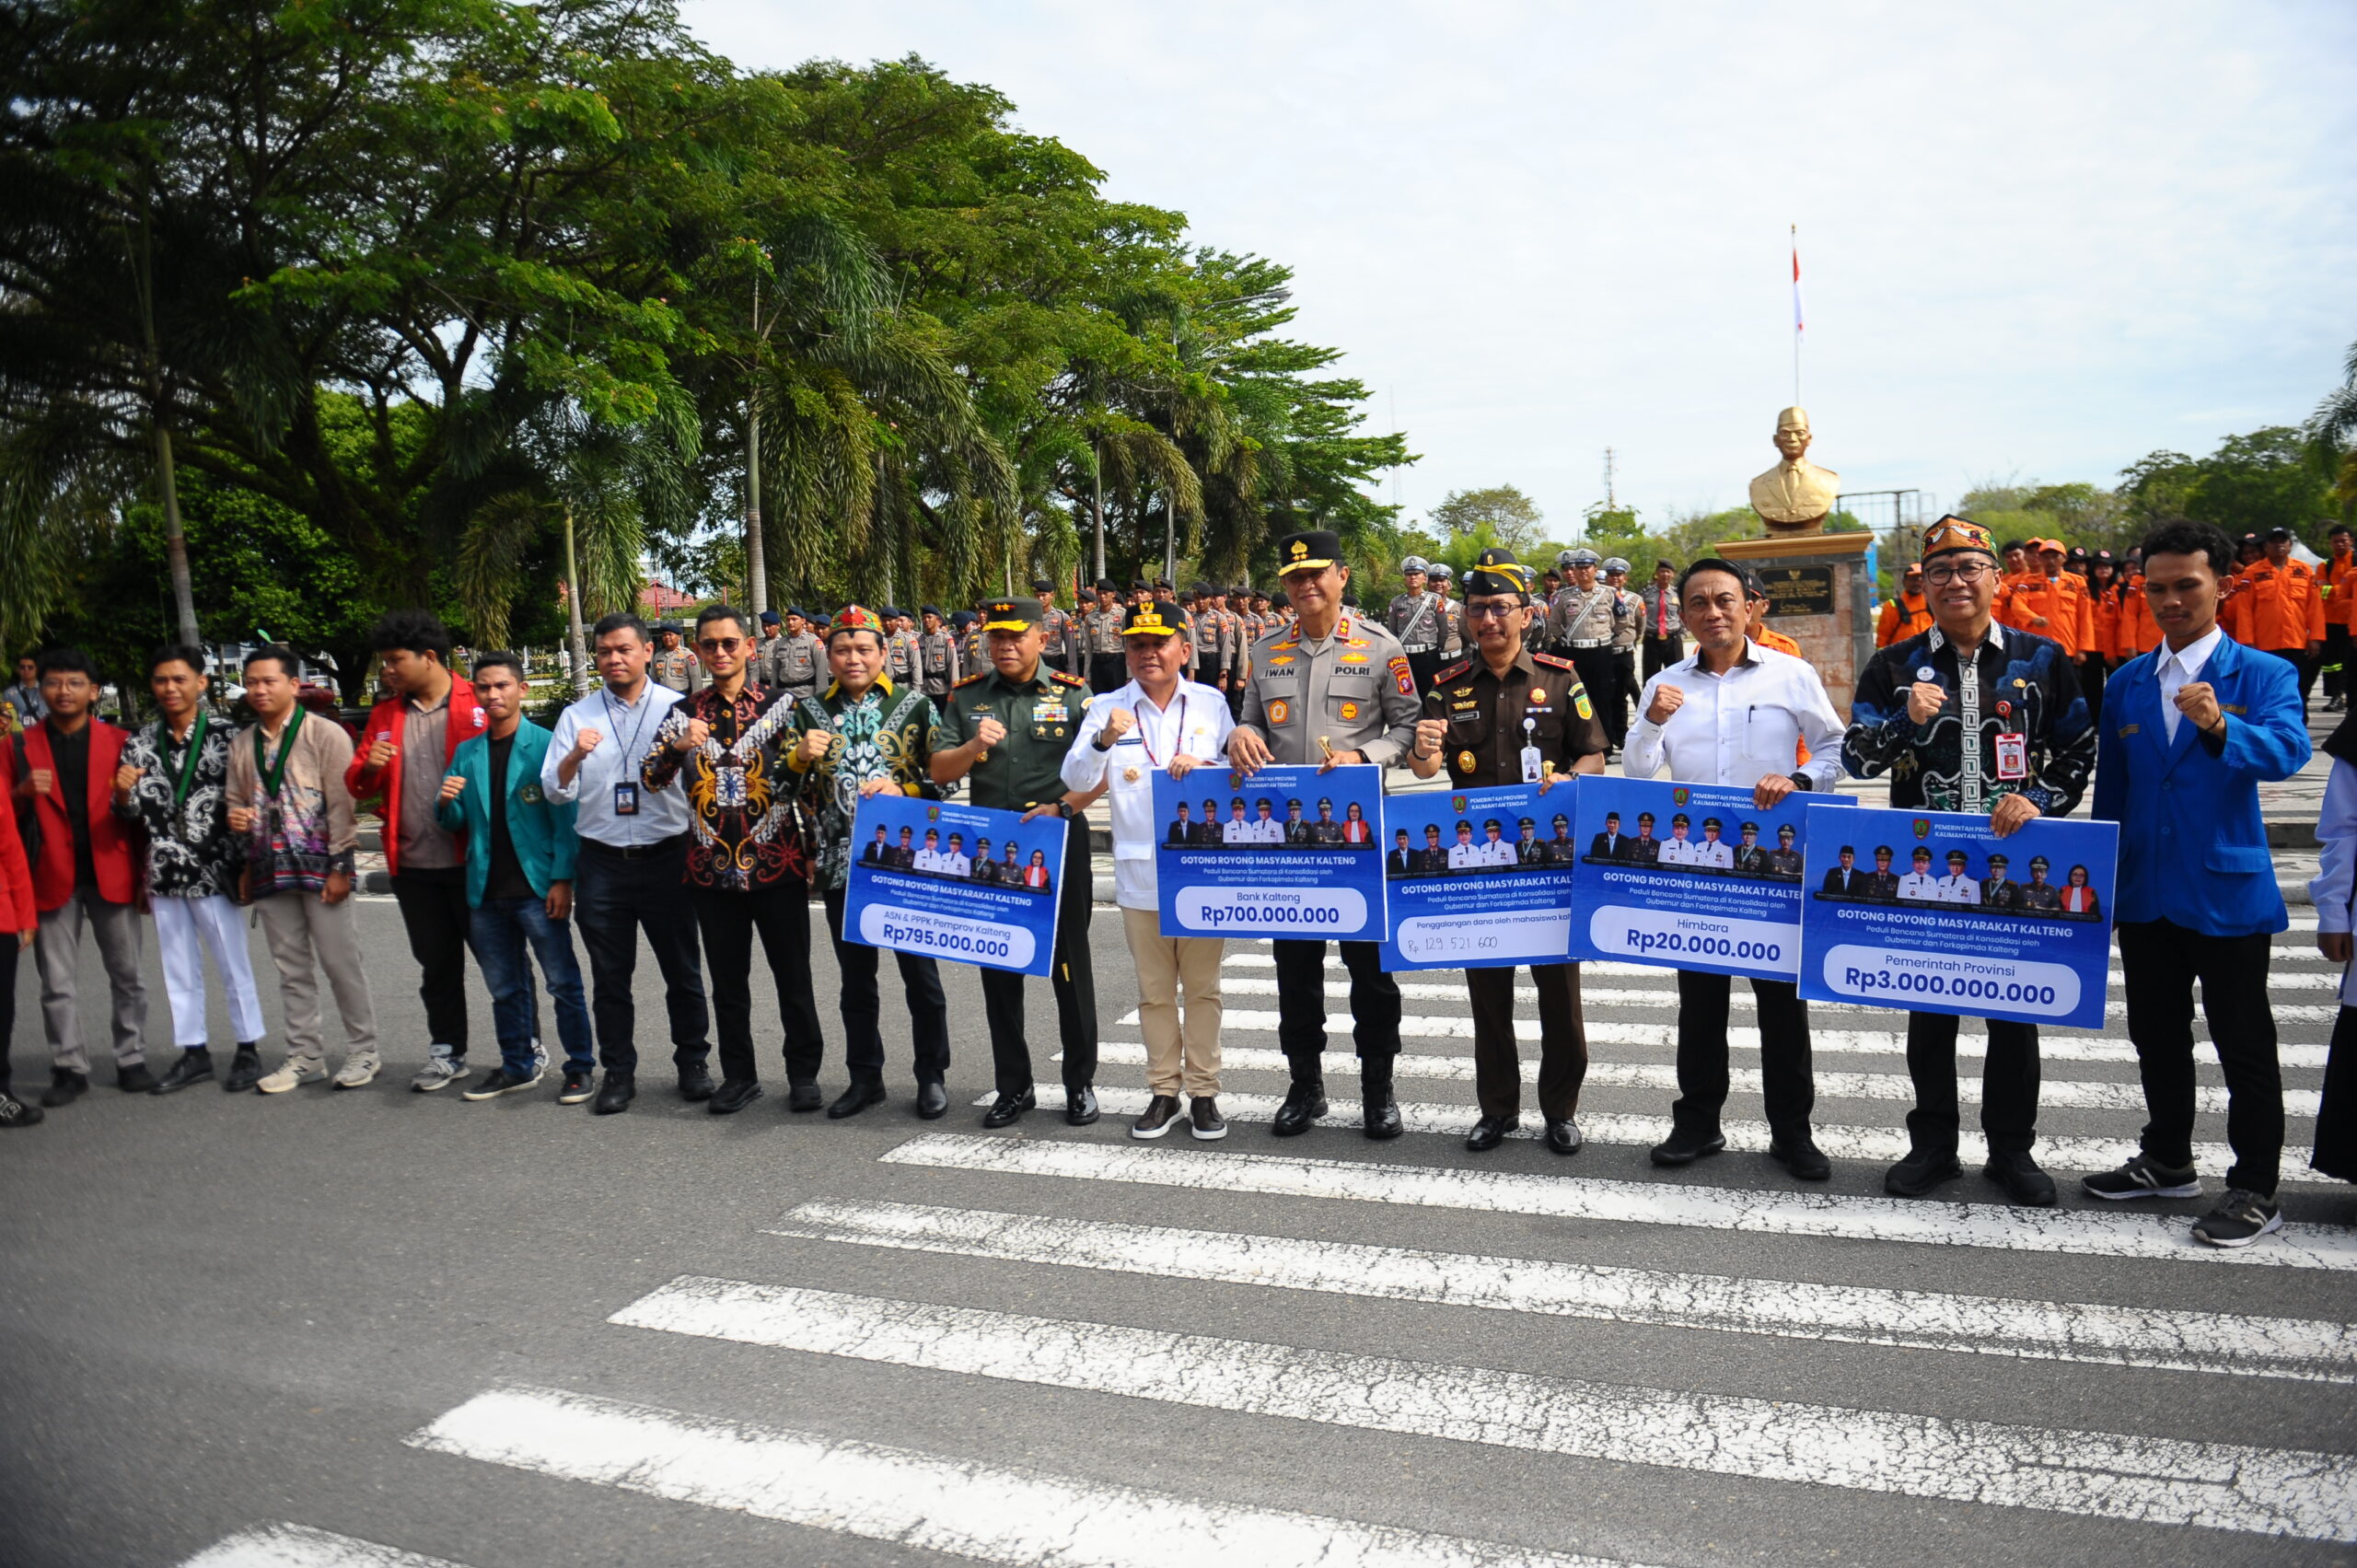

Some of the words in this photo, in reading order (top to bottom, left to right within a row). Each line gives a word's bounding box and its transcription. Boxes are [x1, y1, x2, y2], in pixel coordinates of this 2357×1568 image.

[1265, 667, 1295, 678] IWAN
[1335, 667, 1370, 676] POLRI
[1935, 831, 1976, 840] KALIMANTAN
[1180, 856, 1217, 865] GOTONG
[1218, 856, 1254, 865] ROYONG
[1256, 856, 1314, 865] MASYARAKAT
[872, 876, 904, 887] GOTONG
[905, 880, 939, 892] ROYONG
[940, 884, 994, 900] MASYARAKAT
[995, 892, 1031, 906] KALTENG
[1401, 884, 1442, 894] GOTONG
[1444, 882, 1483, 891] ROYONG
[1486, 877, 1551, 889] MASYARAKAT
[1553, 876, 1573, 884] KAL
[1603, 872, 1647, 884] GOTONG
[1649, 877, 1692, 889] ROYONG
[1694, 881, 1766, 896] MASYARAKAT
[1237, 892, 1260, 901] Bank
[1262, 892, 1300, 904] Kalteng
[1478, 892, 1510, 900] Sumatera
[1518, 889, 1555, 898] Konsolidasi
[1490, 900, 1528, 908] Forkopimda
[1530, 898, 1555, 906] Kalteng
[1652, 890, 1682, 899] Bencana
[1684, 892, 1719, 902] Sumatera
[1728, 897, 1768, 907] Konsolidasi
[1202, 906, 1339, 926] Rp700.000.000
[1645, 898, 1678, 907] Gubernur
[1695, 903, 1737, 912] Forkopimda
[1739, 908, 1767, 917] Kalteng
[884, 912, 901, 920] ASN
[911, 915, 932, 924] PPPK
[934, 918, 974, 932] Pemprov
[976, 925, 1011, 939] Kalteng
[1417, 920, 1471, 930] Penggalangan
[1513, 914, 1557, 923] mahasiswa
[1678, 919, 1729, 933] Himbara
[1838, 910, 1886, 922] GOTONG
[1887, 913, 1936, 925] ROYONG
[1938, 918, 2018, 933] MASYARAKAT
[2020, 924, 2073, 937] KALTENG
[884, 924, 1008, 957] Rp795.000.000
[1627, 929, 1781, 961] Rp20.000.000
[1866, 925, 1889, 934] Peduli
[1890, 927, 1925, 937] Bencana
[1926, 931, 1965, 941] Sumatera
[1976, 935, 2021, 945] Konsolidasi
[2023, 938, 2040, 947] oleh
[1408, 940, 1419, 954] Rp
[1885, 936, 1922, 946] Gubernur
[1922, 939, 1938, 947] dan
[1940, 940, 1987, 952] Forkopimda
[1988, 945, 2019, 956] Kalteng
[1886, 955, 1961, 971] Pemerintah
[1964, 962, 2015, 977] Provinsi
[1846, 968, 2055, 1005] Rp3.000.000.000
